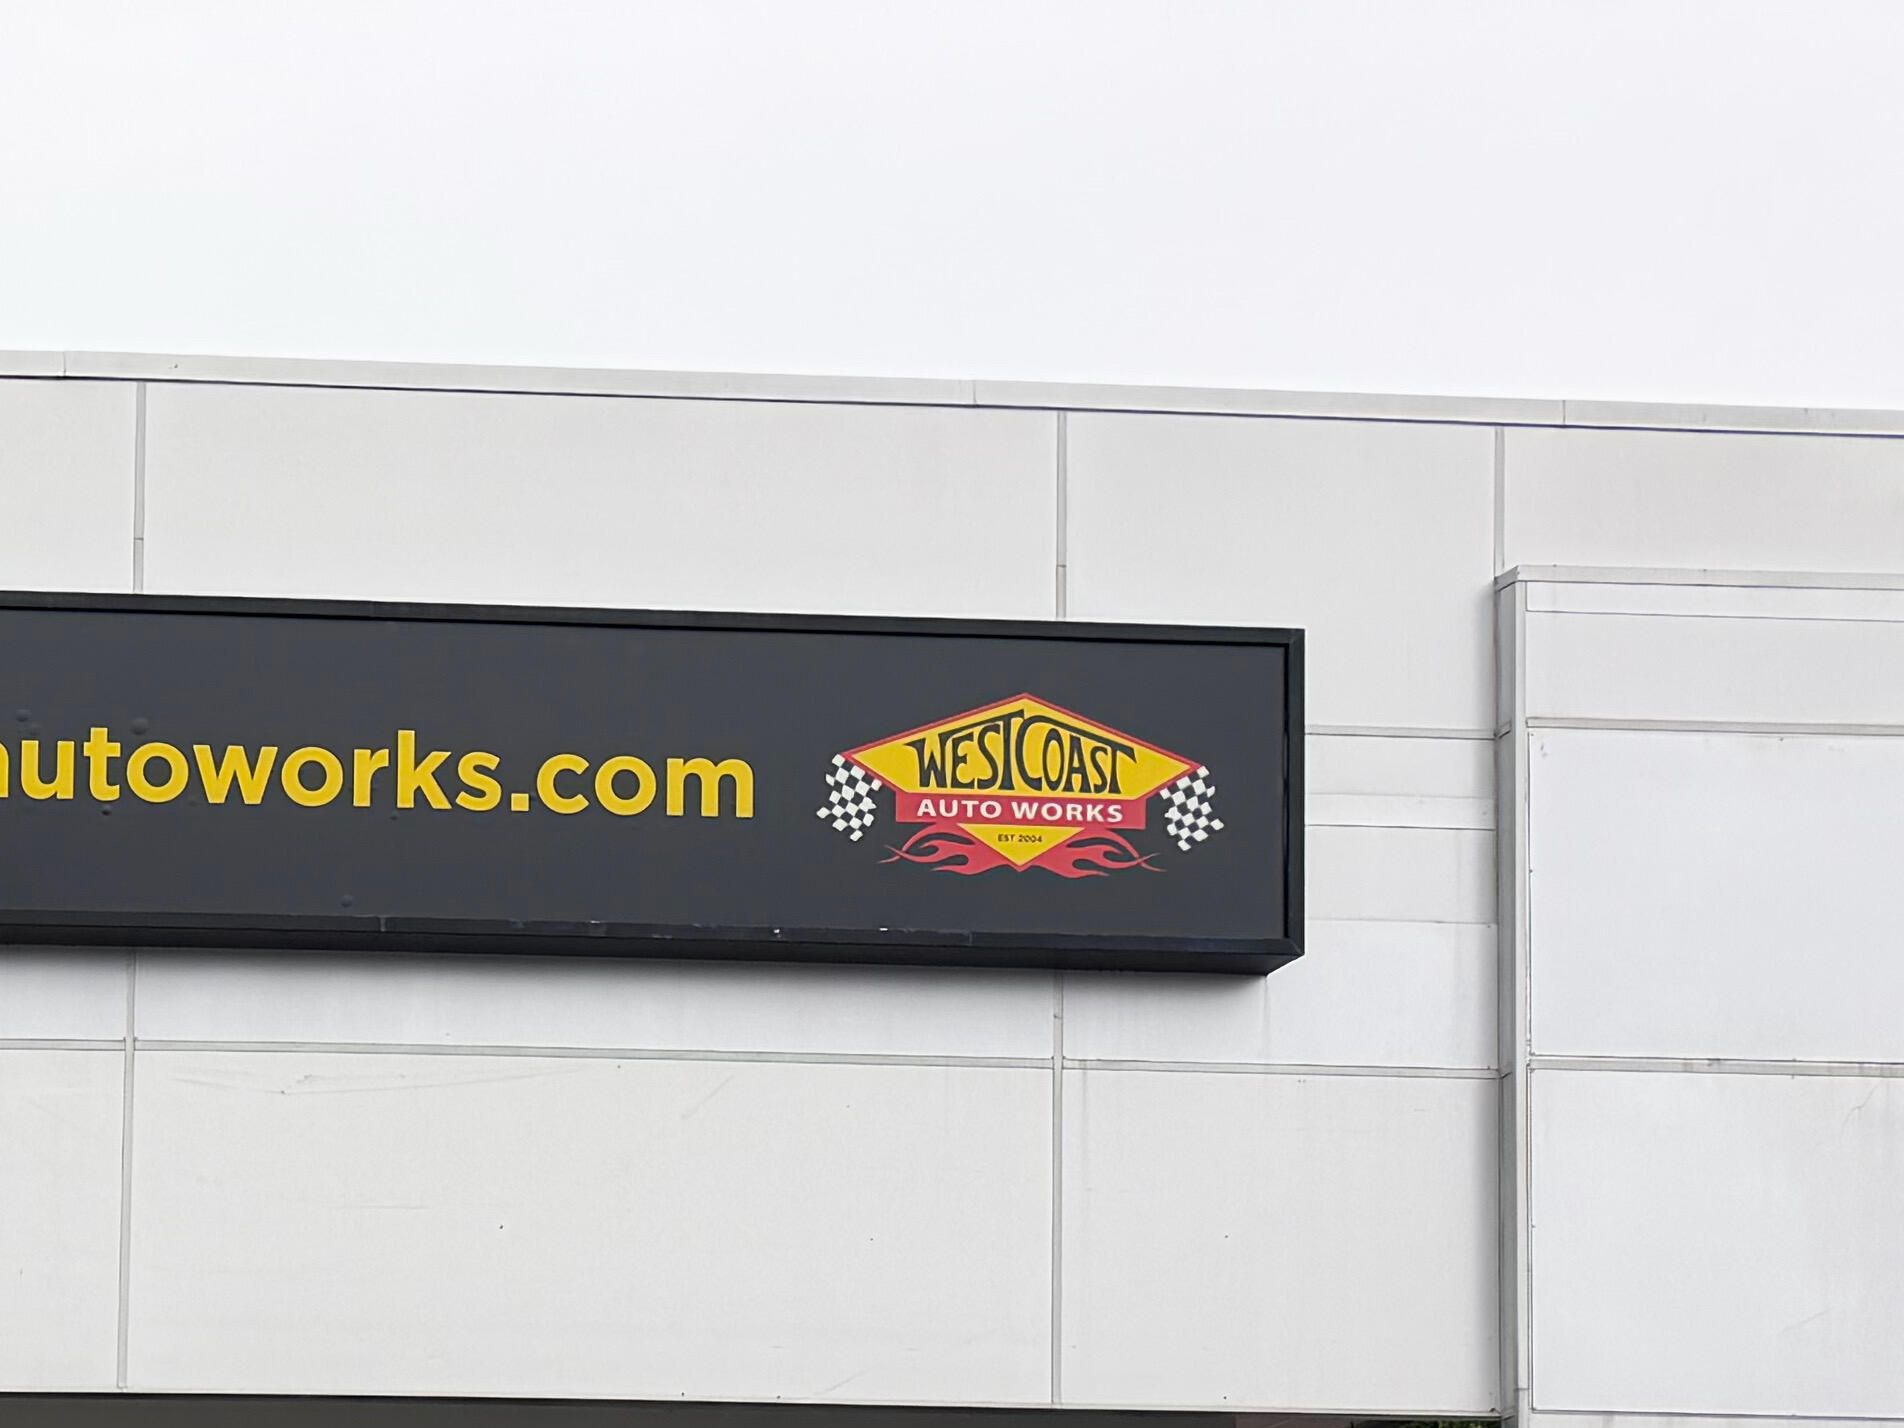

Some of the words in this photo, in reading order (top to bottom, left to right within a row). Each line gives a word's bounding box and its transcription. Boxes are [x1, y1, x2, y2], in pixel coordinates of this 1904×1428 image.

[917, 799, 1004, 820] AUTO
[1011, 800, 1124, 823] WORKS
[997, 833, 1017, 844] EST
[1018, 833, 1043, 844] 2004
